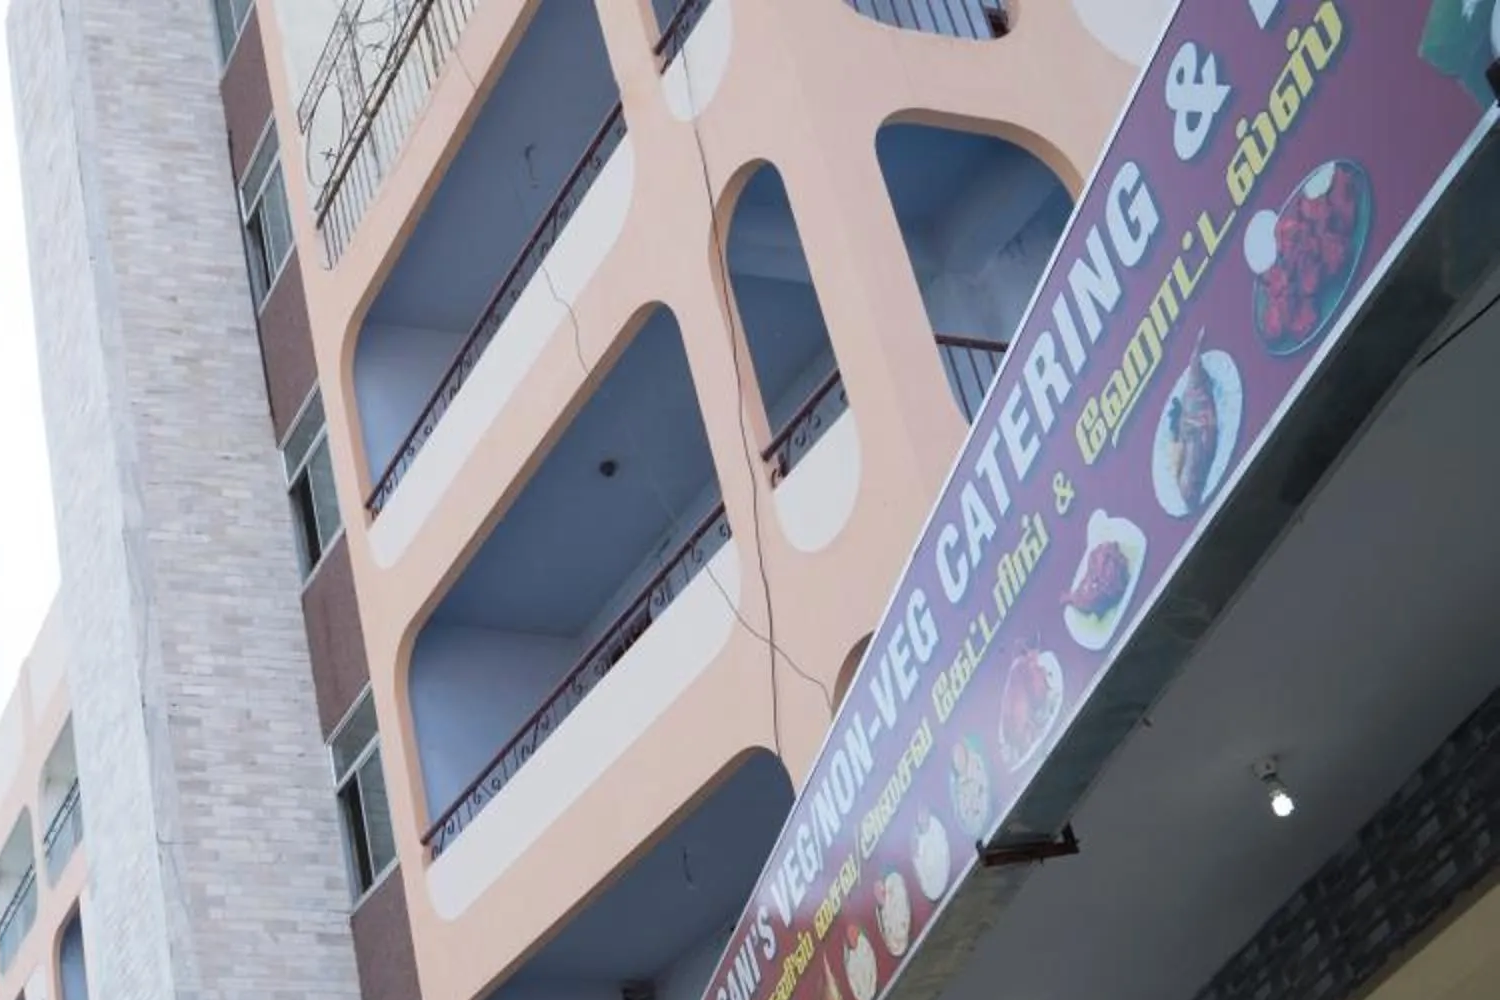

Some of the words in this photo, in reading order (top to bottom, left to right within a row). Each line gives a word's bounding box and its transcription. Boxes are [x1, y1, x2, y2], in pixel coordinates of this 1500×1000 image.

[770, 587, 939, 928] VEG/NON-VEG
[936, 161, 1159, 603] CATERING
[1165, 42, 1231, 160] &
[1053, 471, 1074, 515] &
